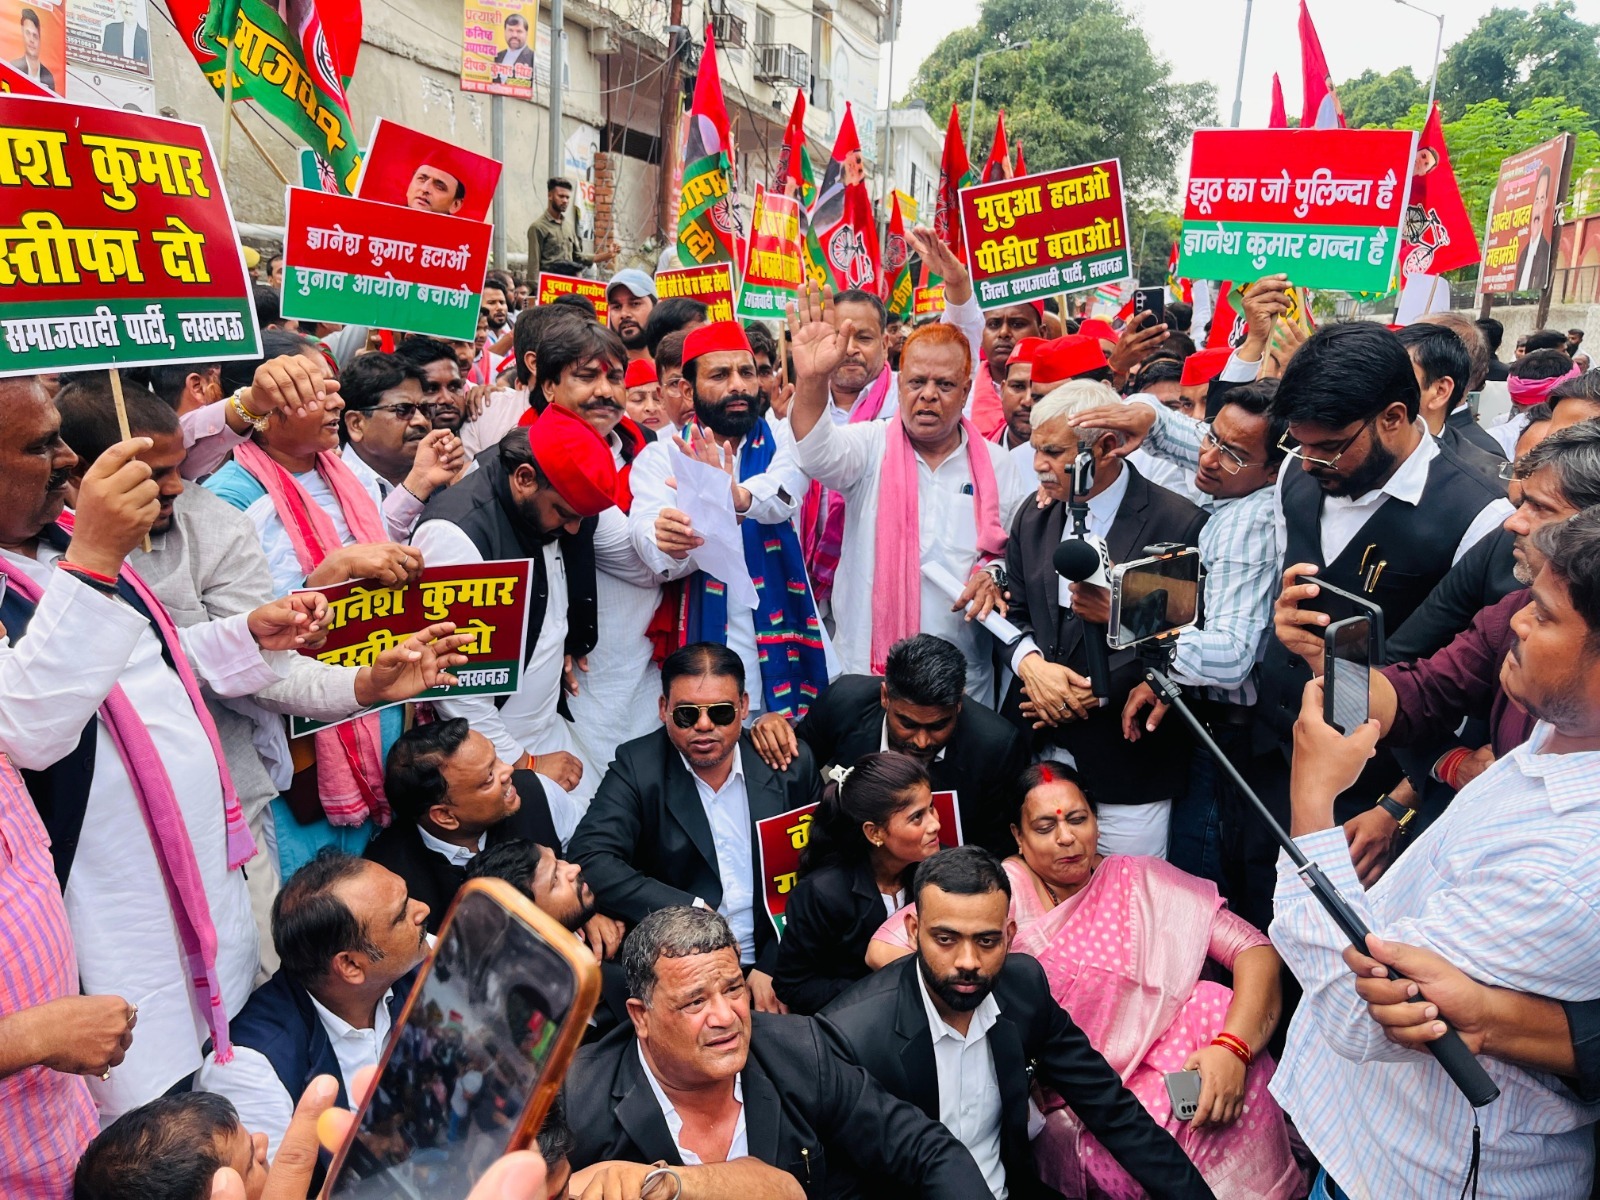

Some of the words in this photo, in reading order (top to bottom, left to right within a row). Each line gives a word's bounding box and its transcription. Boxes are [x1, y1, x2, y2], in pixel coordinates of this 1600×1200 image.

[81, 133, 211, 211] कुमार
[1189, 177, 1225, 214] झूठ
[1227, 177, 1257, 203] का
[1260, 168, 1291, 204] जो
[1293, 167, 1373, 218] पुलिन्दा
[1376, 168, 1397, 209] है
[974, 186, 1042, 233] मुचुआ
[1047, 166, 1110, 209] हटाओ
[153, 216, 211, 283] दो
[306, 224, 364, 256] ज्ञानेश
[368, 236, 417, 267] कुमार
[975, 235, 1039, 274] पीडीए
[1183, 221, 1243, 257] ज्ञानेश
[1246, 231, 1306, 270] कुमार
[1309, 233, 1365, 261] गन्दा
[1368, 225, 1389, 266] है
[294, 266, 348, 296] चुनाव
[352, 271, 413, 301] आयोग
[417, 283, 474, 310] बचाओ
[980, 281, 1008, 302] जिला
[1011, 266, 1060, 295] समाजवादी
[1088, 256, 1123, 278] लखनऊ
[1, 305, 119, 353] समाजवादी
[122, 303, 175, 350] पार्टी,
[178, 311, 245, 343] लखनऊ
[328, 585, 409, 631] ानेश
[419, 576, 519, 621] कुमार
[454, 619, 496, 655] दो
[457, 668, 510, 688] लखनऊ
